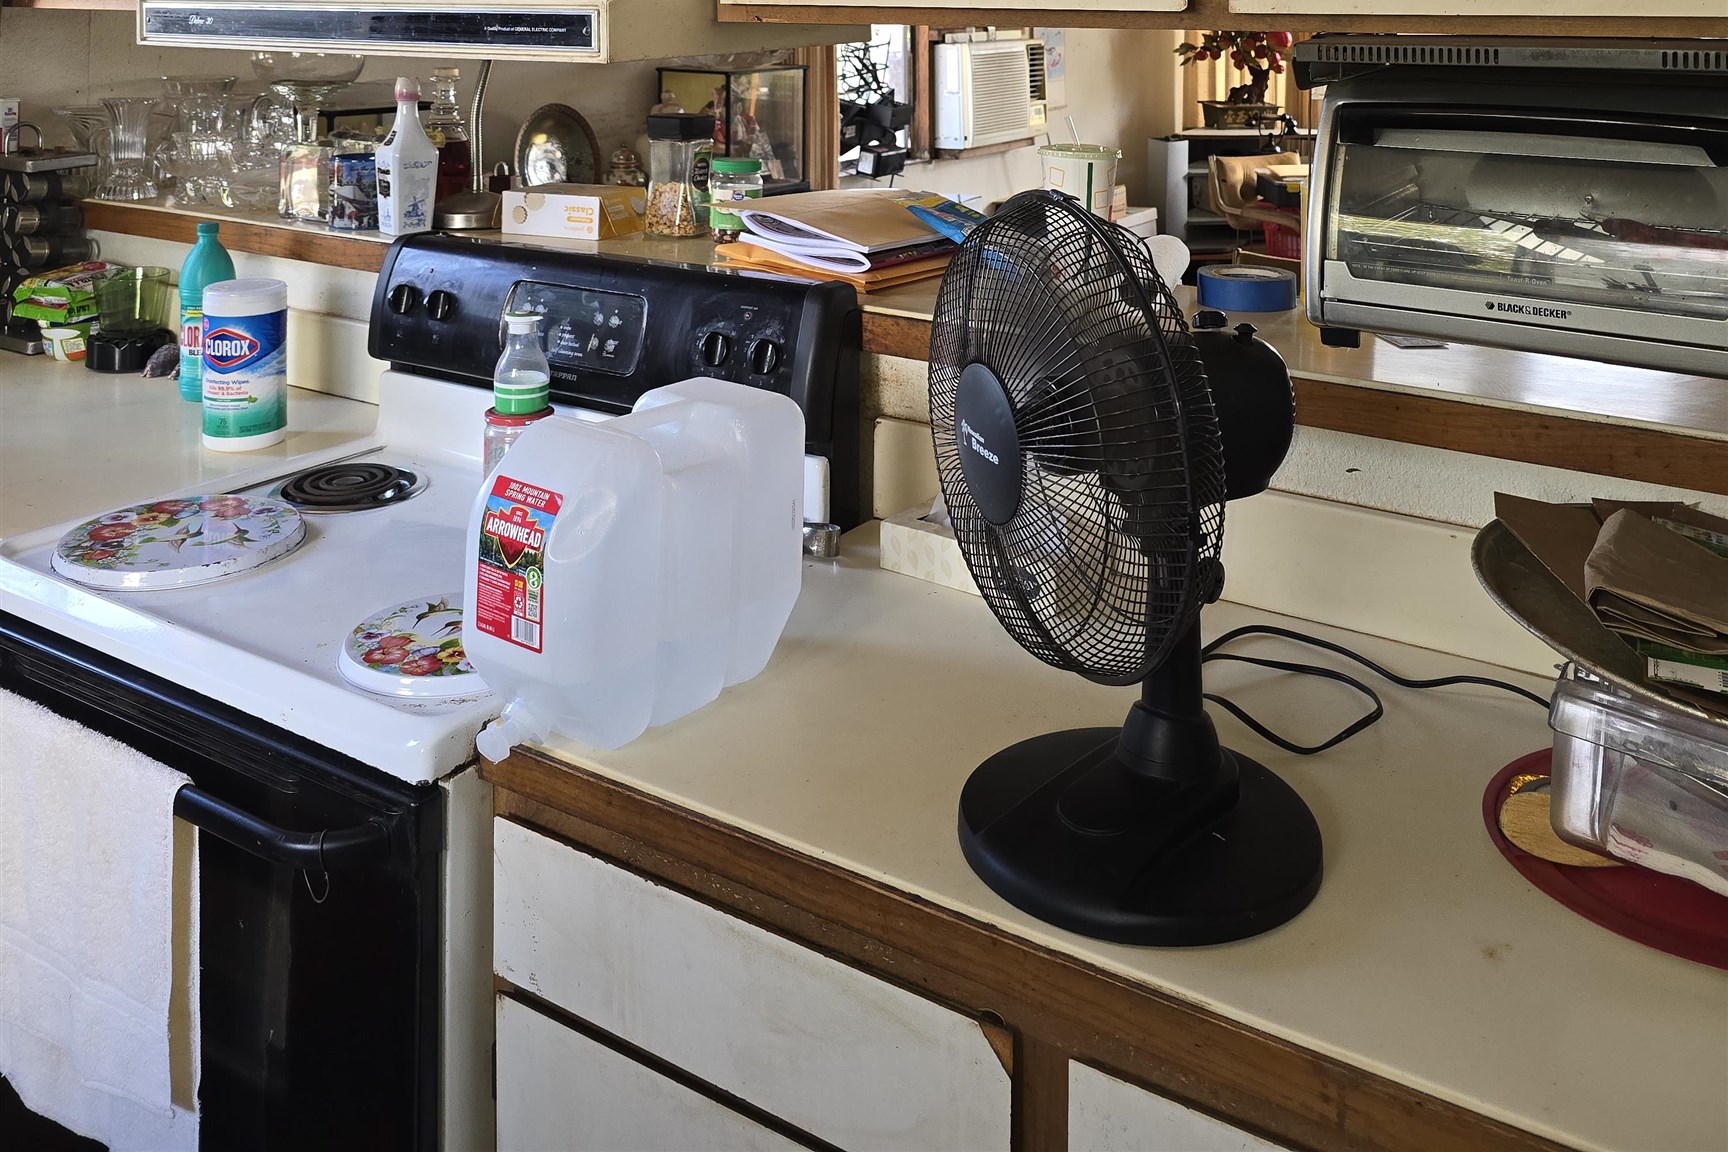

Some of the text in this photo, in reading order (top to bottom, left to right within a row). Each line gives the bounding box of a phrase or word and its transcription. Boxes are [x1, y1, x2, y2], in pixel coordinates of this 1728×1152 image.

[205, 17, 214, 25] 30
[564, 205, 595, 216] Classic
[180, 326, 200, 347] CLOR
[205, 338, 250, 356] CLOROX
[971, 436, 999, 465] Breeze
[504, 489, 546, 508] SPRING WATER
[522, 485, 550, 500] MOUNTAIN
[486, 516, 542, 548] ARROWHEAD
